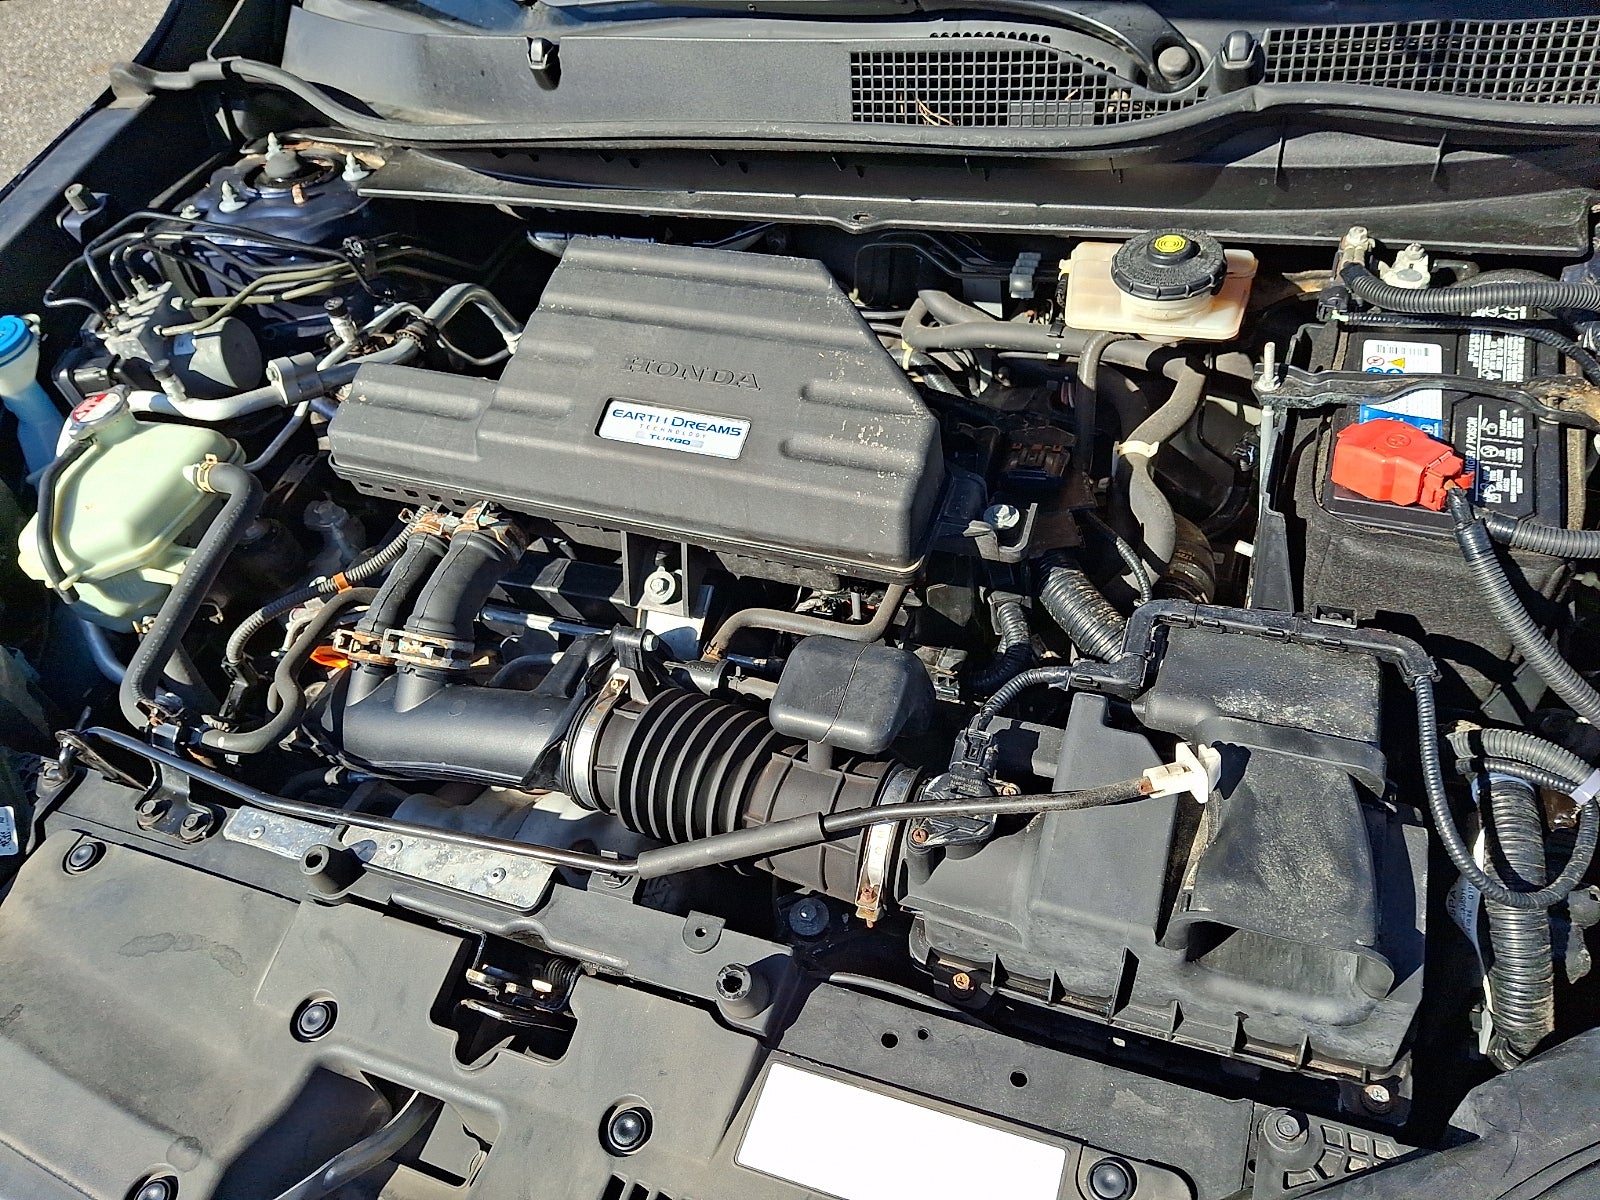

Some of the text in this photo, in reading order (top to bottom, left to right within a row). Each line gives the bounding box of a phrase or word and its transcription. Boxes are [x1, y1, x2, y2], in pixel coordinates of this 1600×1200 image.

[620, 356, 762, 391] HONDA
[639, 424, 707, 439] TECHNOLOGY
[671, 417, 743, 437] DREAMS
[649, 433, 691, 446] TURBO
